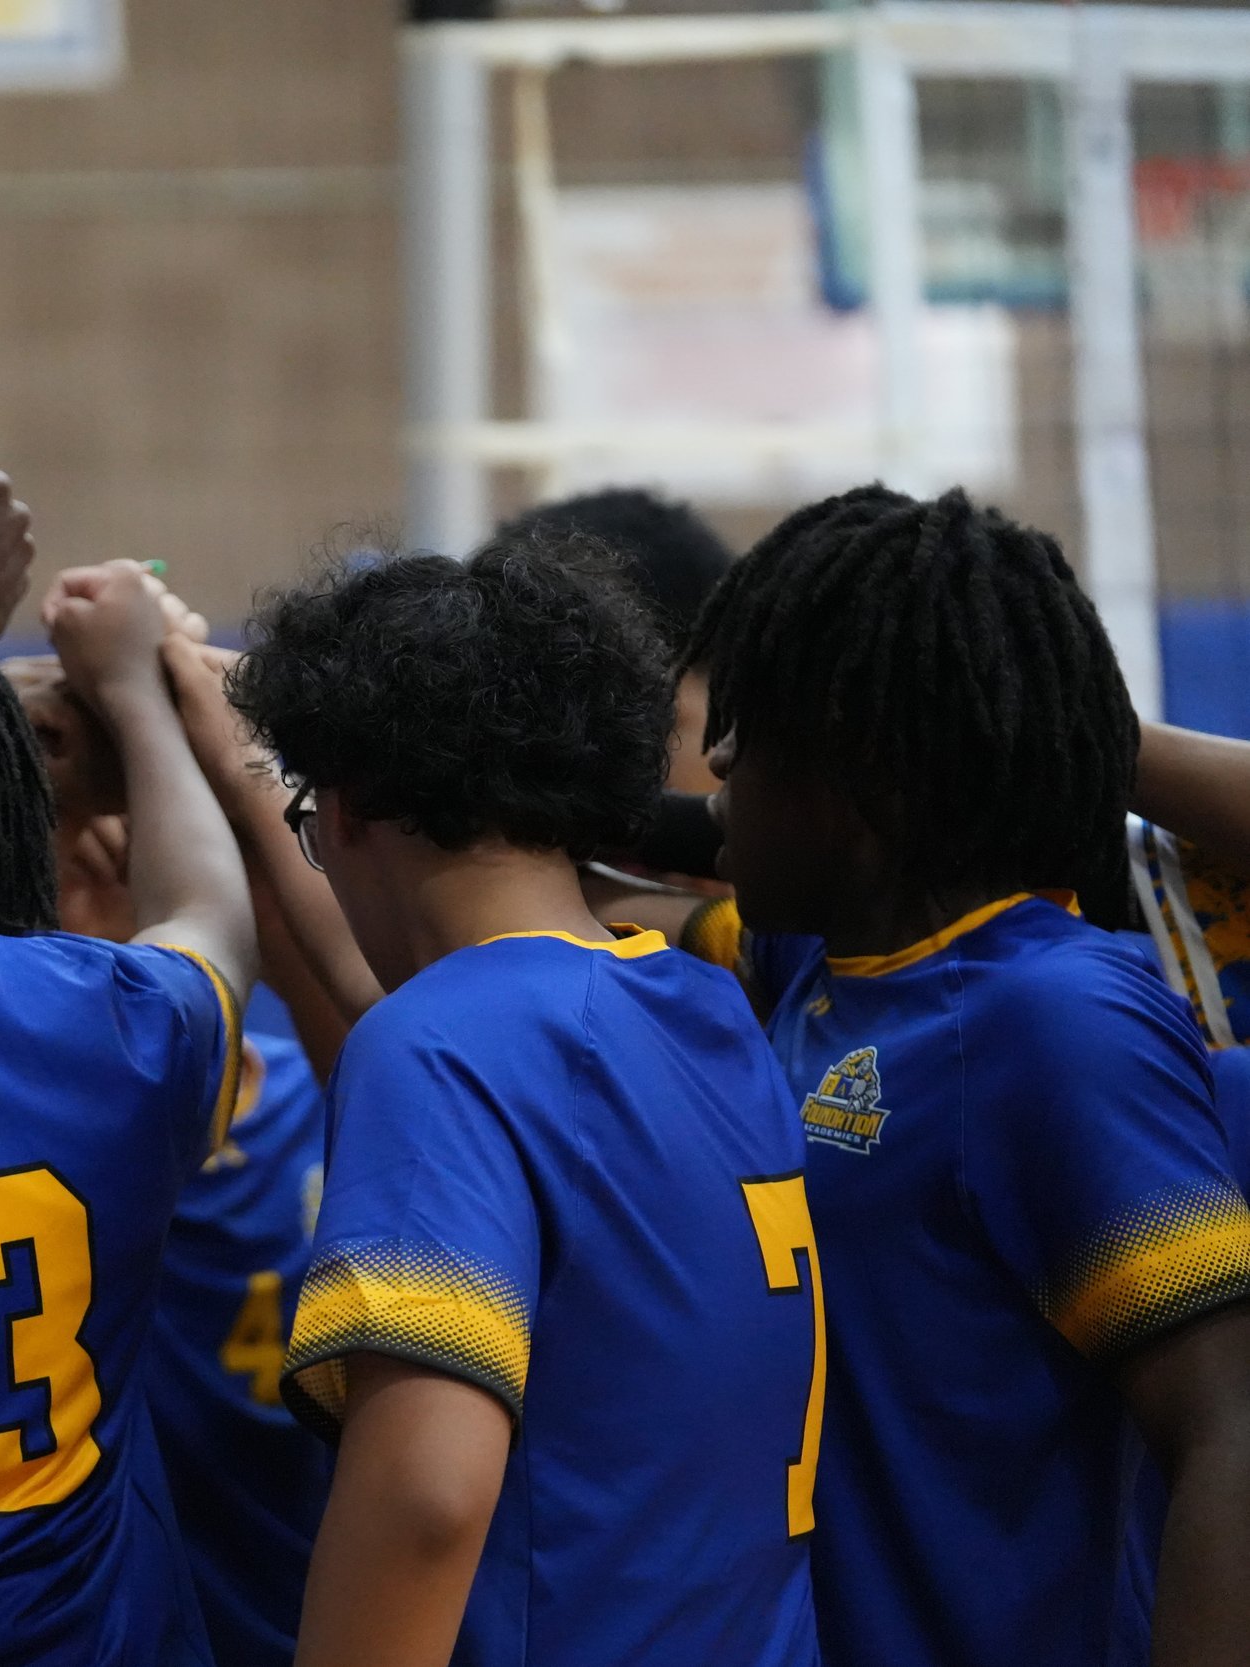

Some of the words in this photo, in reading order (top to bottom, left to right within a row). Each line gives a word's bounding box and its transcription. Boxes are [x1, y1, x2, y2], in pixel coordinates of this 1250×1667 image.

[803, 1098, 881, 1138] FOUNDATION
[218, 1270, 285, 1405] 4
[740, 1173, 828, 1540] 7
